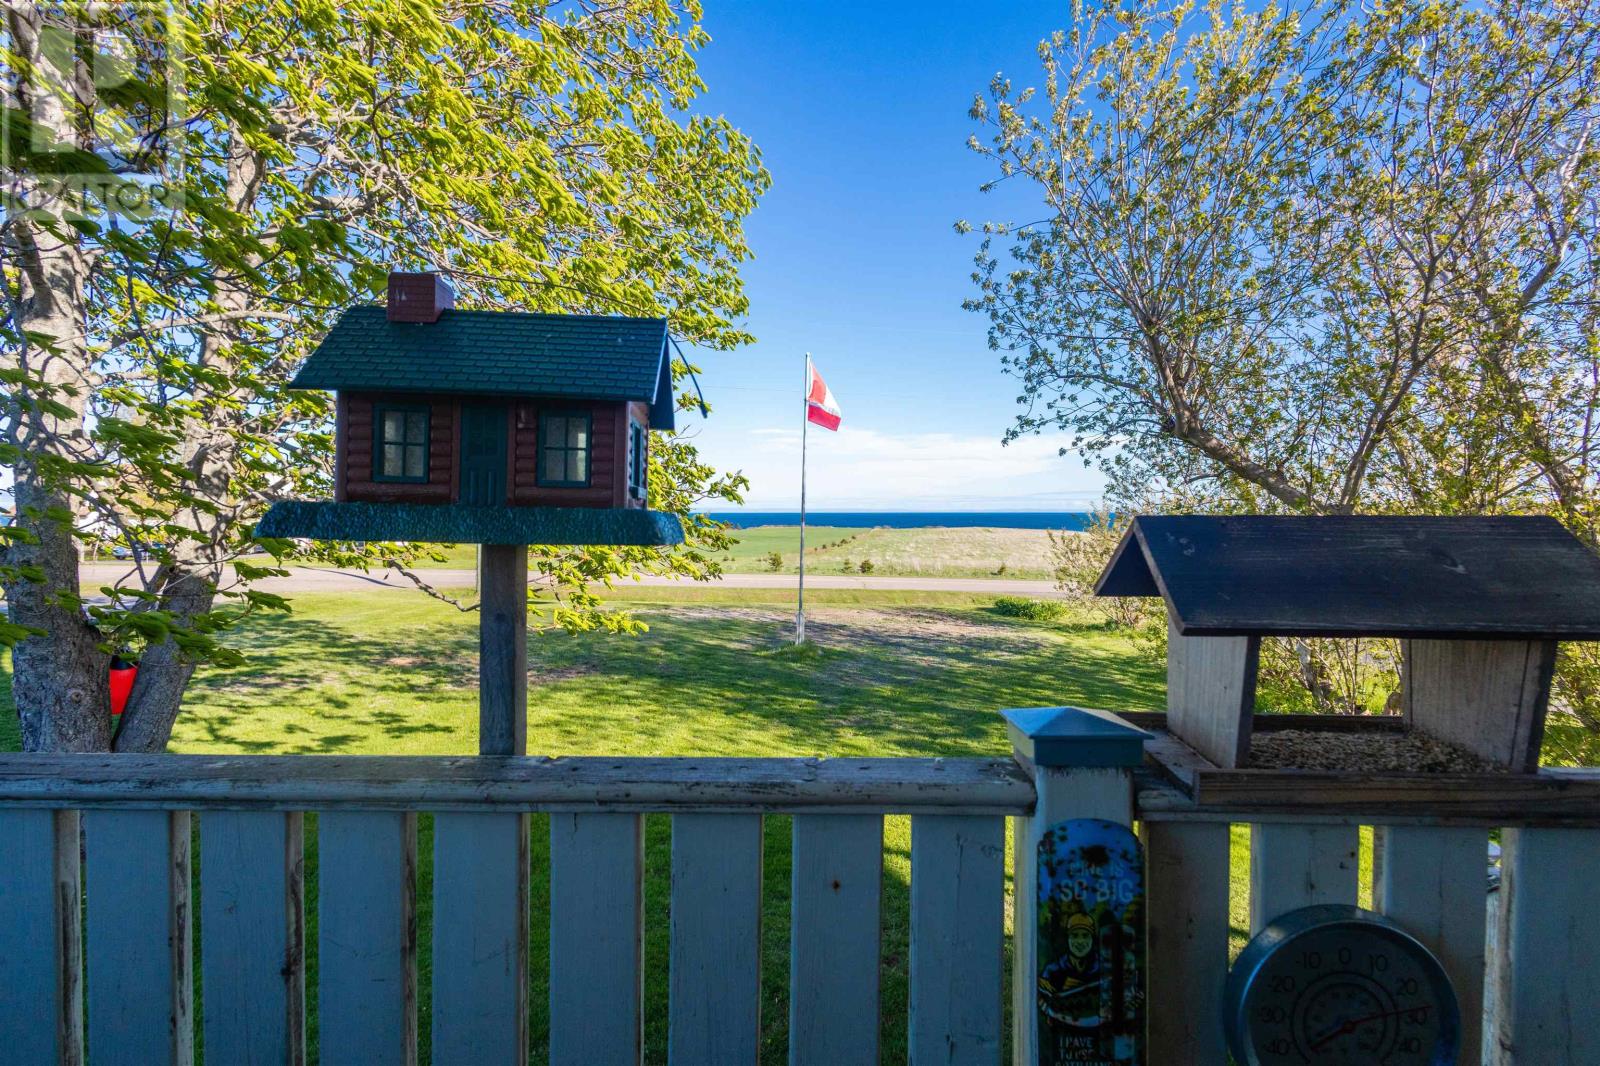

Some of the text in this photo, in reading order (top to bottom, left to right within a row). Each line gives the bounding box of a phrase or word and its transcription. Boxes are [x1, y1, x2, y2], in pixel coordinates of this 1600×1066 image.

[1060, 880, 1134, 904] SO BIG
[1295, 952, 1322, 969] -10
[1337, 946, 1352, 965] 0
[1369, 953, 1389, 972] 10
[1396, 978, 1419, 996] 20
[1398, 1037, 1421, 1054] 40
